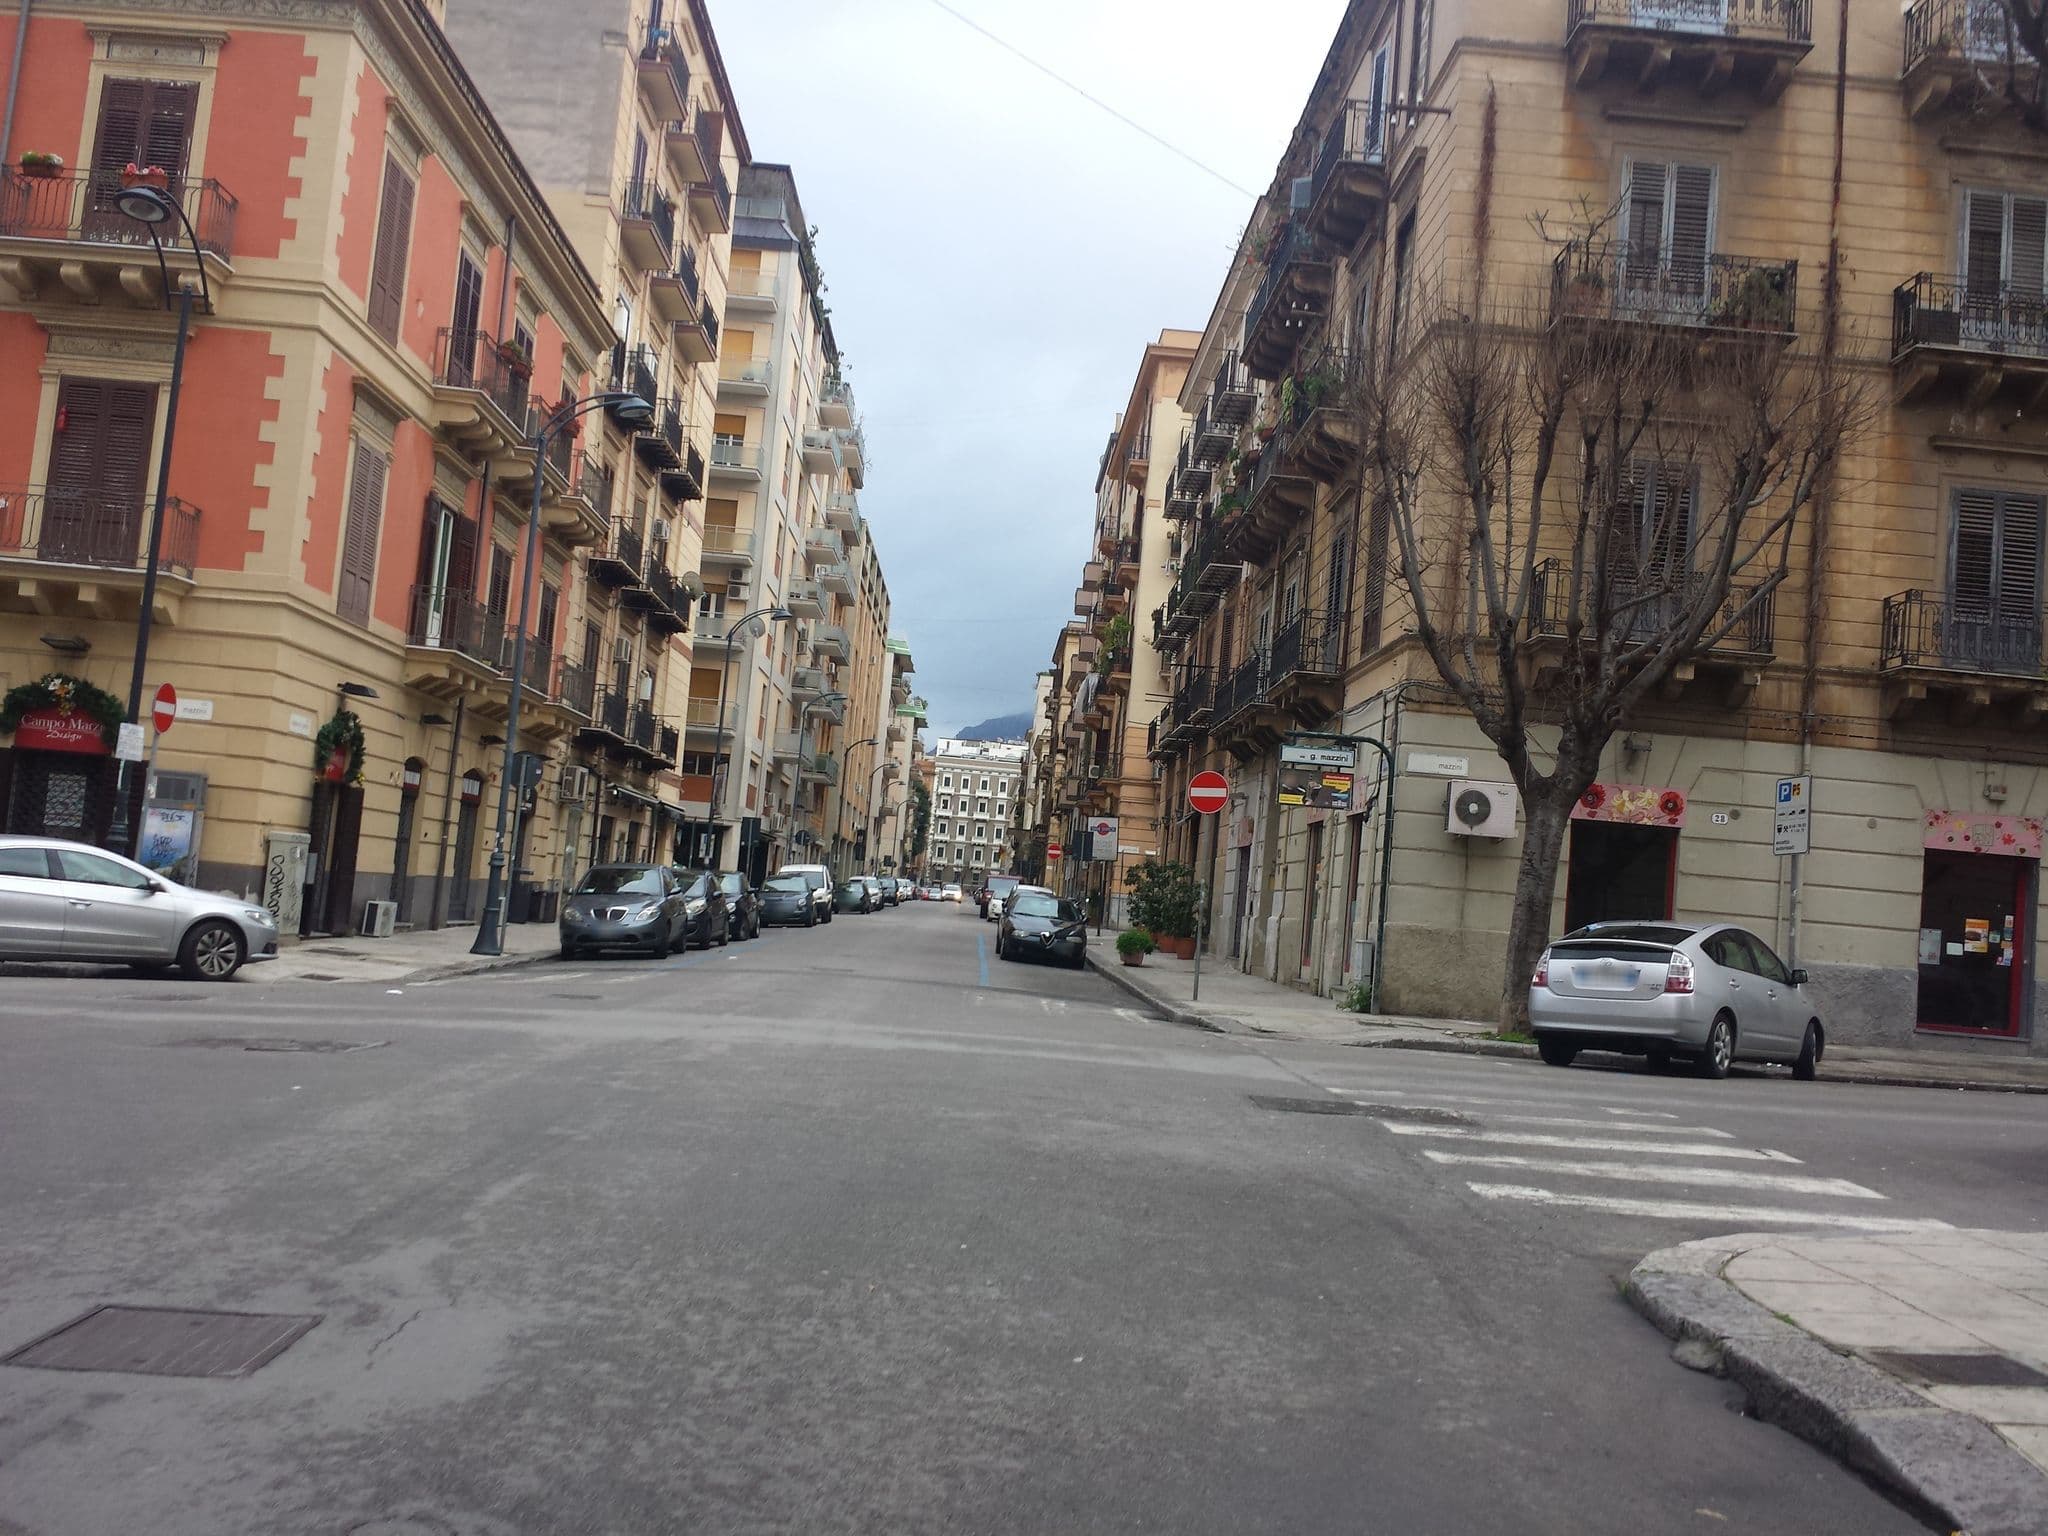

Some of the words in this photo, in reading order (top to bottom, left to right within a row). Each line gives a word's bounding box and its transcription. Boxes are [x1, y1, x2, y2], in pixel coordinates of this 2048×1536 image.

[21, 714, 66, 731] Campo
[1320, 754, 1349, 762] mazzini
[1438, 762, 1463, 771] mazzini
